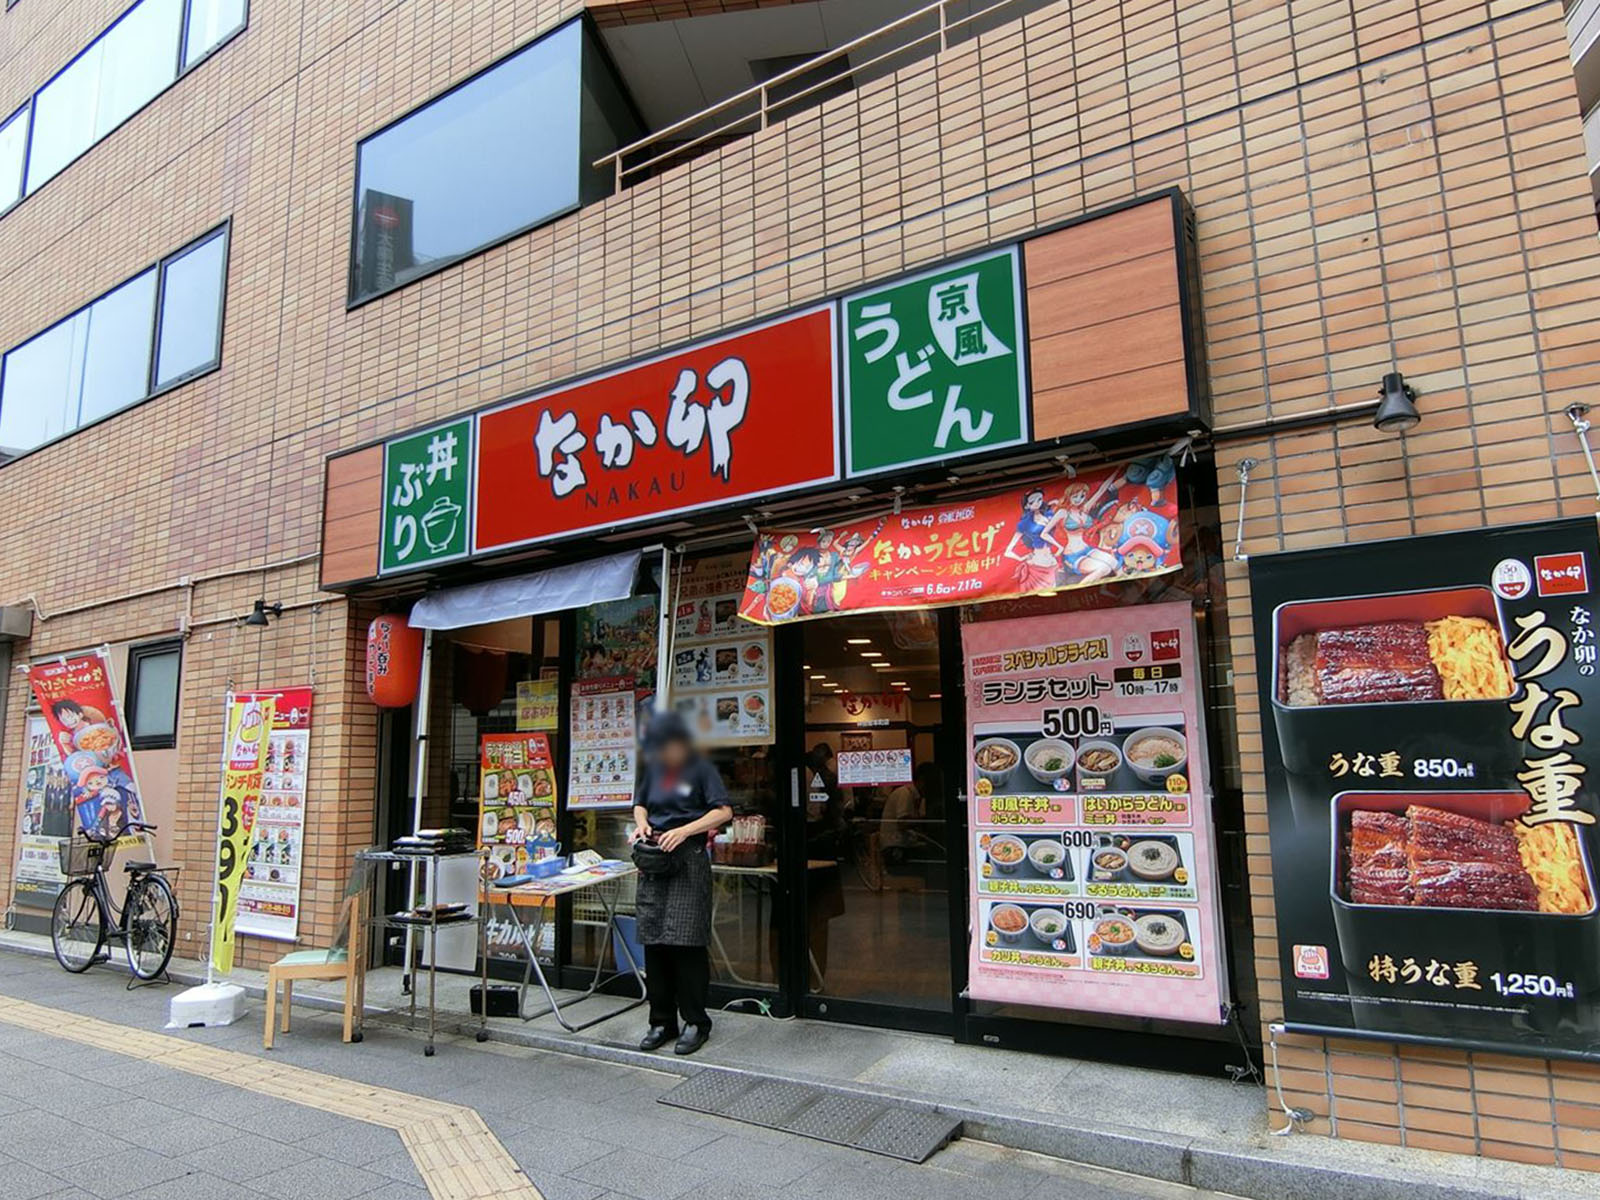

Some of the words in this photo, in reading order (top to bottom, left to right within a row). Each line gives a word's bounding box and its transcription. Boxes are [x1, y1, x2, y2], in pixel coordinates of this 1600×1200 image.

[937, 284, 988, 358] 京風
[855, 302, 994, 449] うどん
[535, 357, 749, 498] なか卯
[585, 472, 686, 511] NAKAU
[873, 520, 1006, 566] なかうたげ
[1540, 565, 1582, 581] なか卯
[1569, 605, 1596, 676] なか卯の
[984, 674, 1113, 705] ランチセット
[1132, 667, 1169, 682] 毎日
[1042, 706, 1115, 737] 500円
[1508, 611, 1597, 826] うな重
[1329, 751, 1404, 778] うな重
[1085, 797, 1174, 812] はいからうどん
[1063, 831, 1093, 847] 600
[1065, 902, 1096, 919] 690
[1368, 955, 1482, 990] 特うな重
